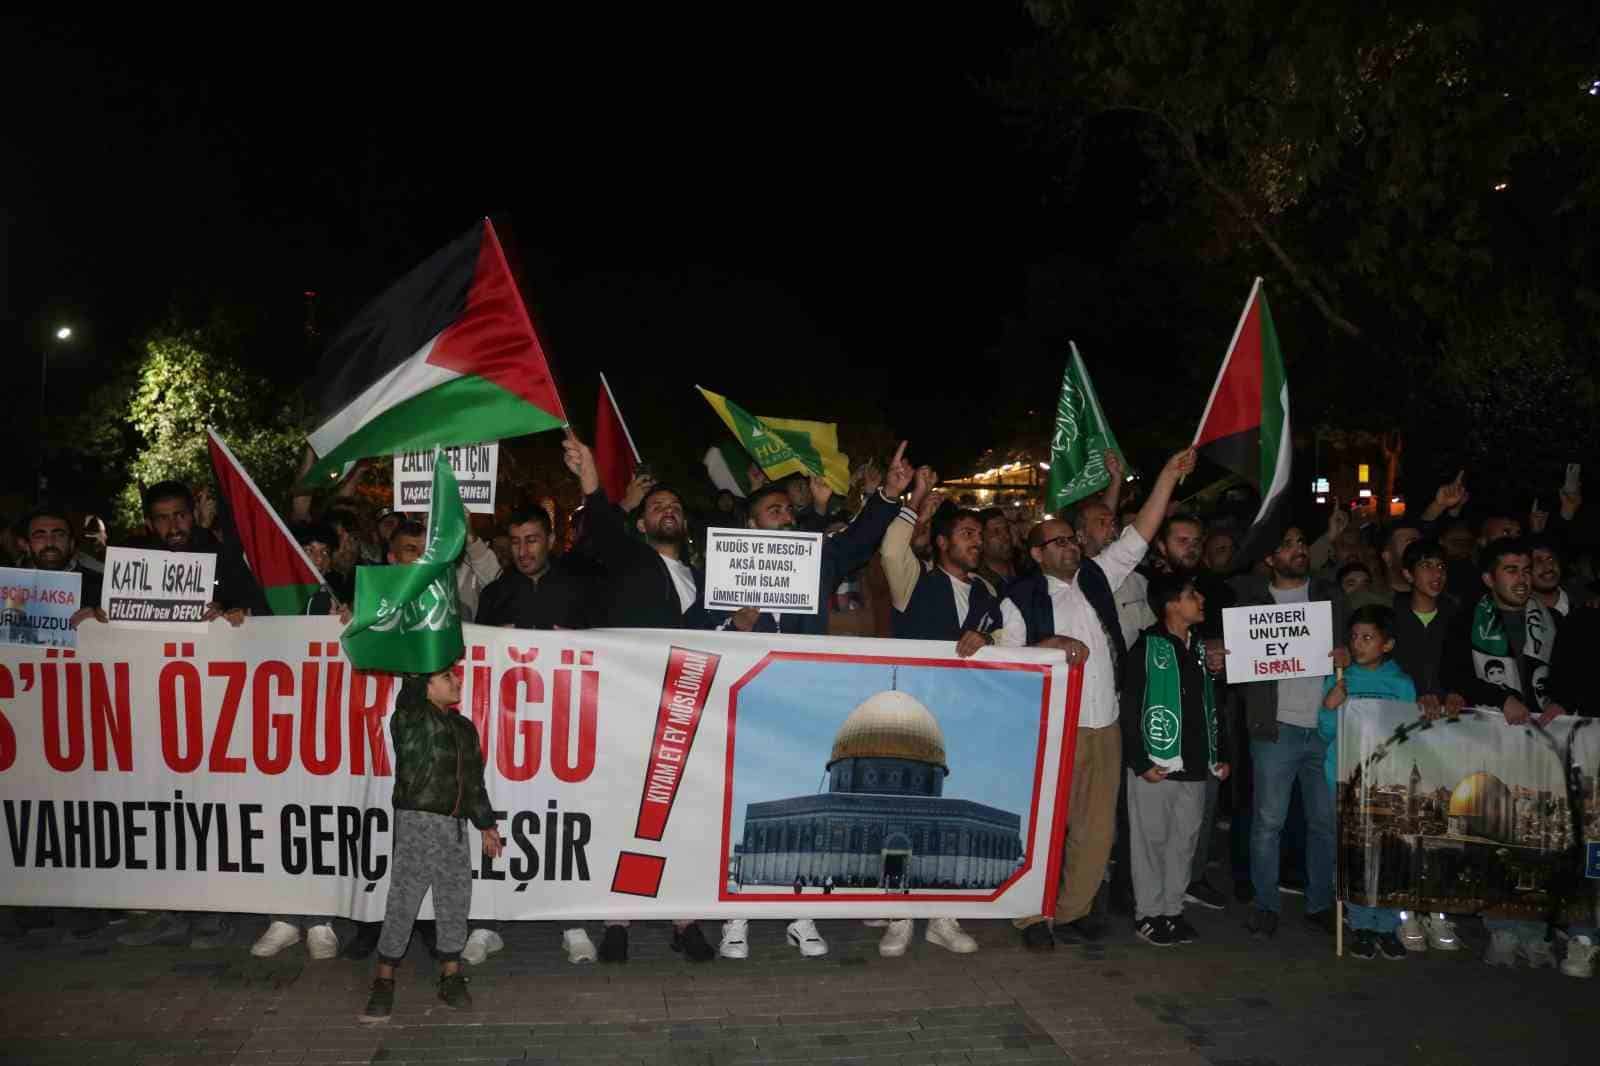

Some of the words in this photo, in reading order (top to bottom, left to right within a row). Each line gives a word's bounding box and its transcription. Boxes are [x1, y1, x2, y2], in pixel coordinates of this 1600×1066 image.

[458, 486, 489, 500] ENNEM
[716, 539, 749, 554] KUDÜS
[752, 543, 764, 554] VE
[767, 542, 813, 556] MESCİD-İ
[112, 558, 152, 591] KATİL
[162, 560, 206, 593] İSRAİL
[735, 572, 757, 587] TÜM
[760, 574, 790, 588] İSLAM
[0, 585, 38, 602] SCİD-İ
[40, 589, 75, 605] AKSA
[713, 587, 761, 603] ÜMMETİNİN
[763, 592, 810, 605] DAVASIDIR!
[172, 604, 202, 620] DEFOL
[1249, 607, 1305, 625] HAYBERİ
[1249, 625, 1310, 640] UNUTMA
[1266, 643, 1288, 656] EY
[1255, 657, 1306, 675] İSRAİL
[668, 652, 709, 725] MÜSLÜMAN
[663, 726, 687, 744] EY
[657, 745, 682, 762] ET
[646, 763, 679, 804] KIYAM
[3, 790, 264, 873] VAHDETİYLE
[280, 799, 592, 892] GERÇEŞİR
